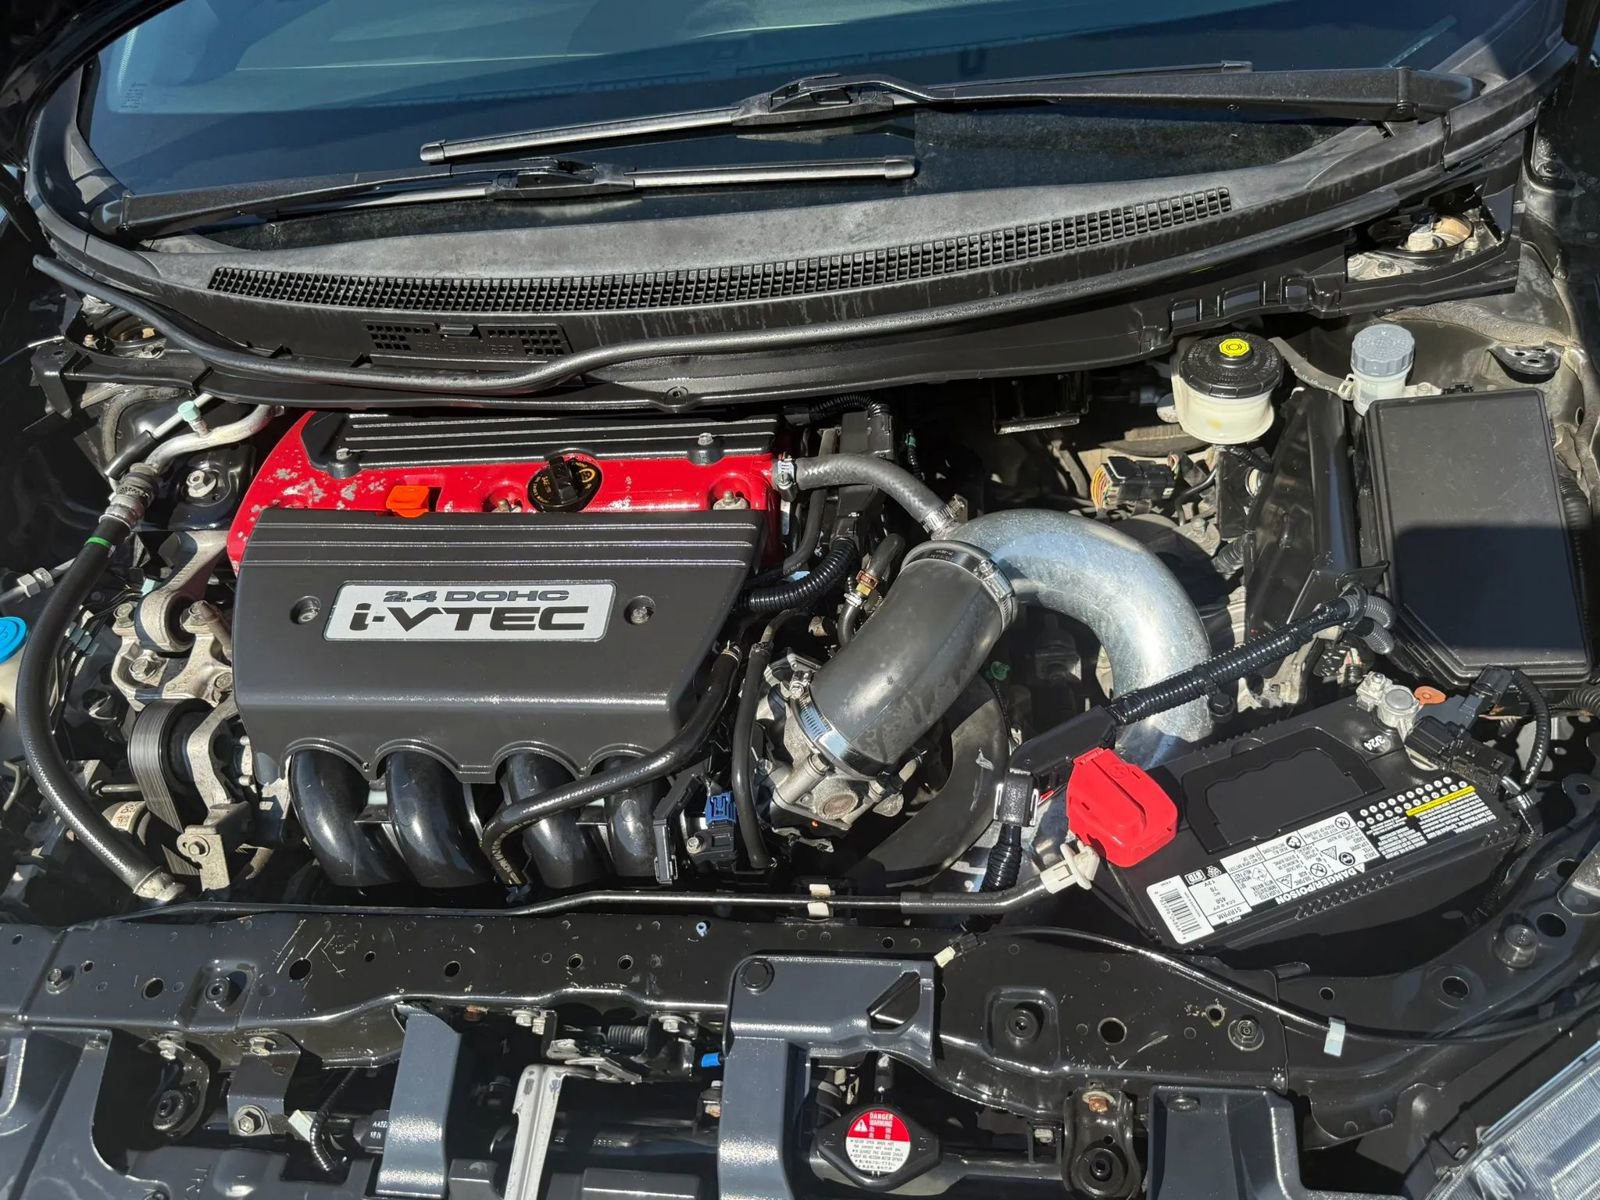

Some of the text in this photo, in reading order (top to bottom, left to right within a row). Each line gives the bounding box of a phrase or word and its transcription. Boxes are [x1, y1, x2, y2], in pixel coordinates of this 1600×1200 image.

[384, 590, 569, 603] 2.4 DOHC
[349, 602, 589, 632] i-VTEC
[1363, 735, 1386, 751] 3/24
[1273, 867, 1356, 904] DANGER/POISON
[869, 1112, 893, 1120] DANGER
